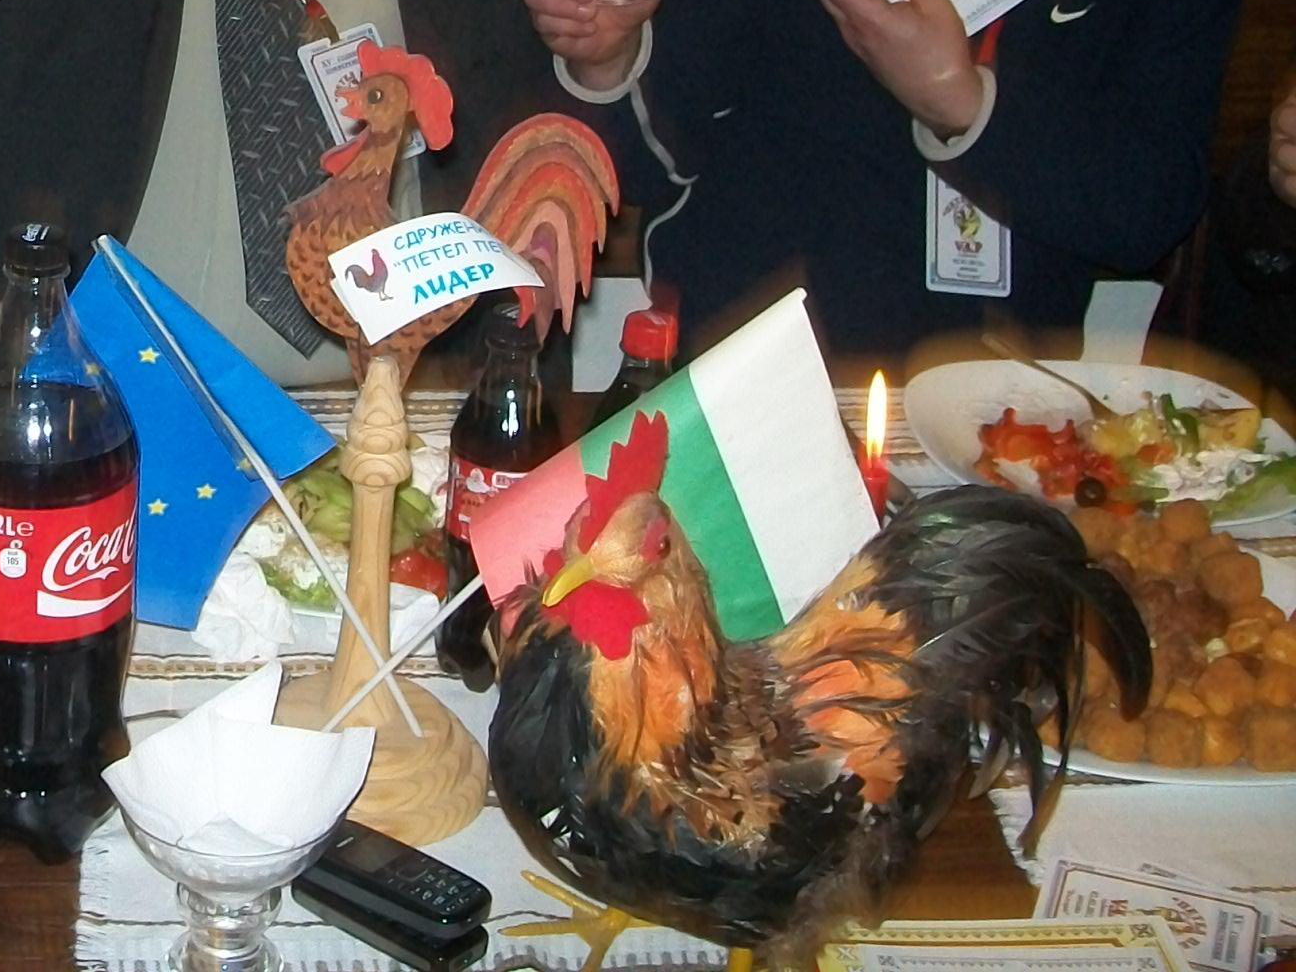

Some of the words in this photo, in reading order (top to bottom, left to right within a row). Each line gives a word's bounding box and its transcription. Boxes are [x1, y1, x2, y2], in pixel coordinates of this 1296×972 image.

[393, 241, 470, 274] "ПЕТЕЛ
[472, 239, 506, 255] ПЕ
[412, 262, 496, 305] ЛИДЕР
